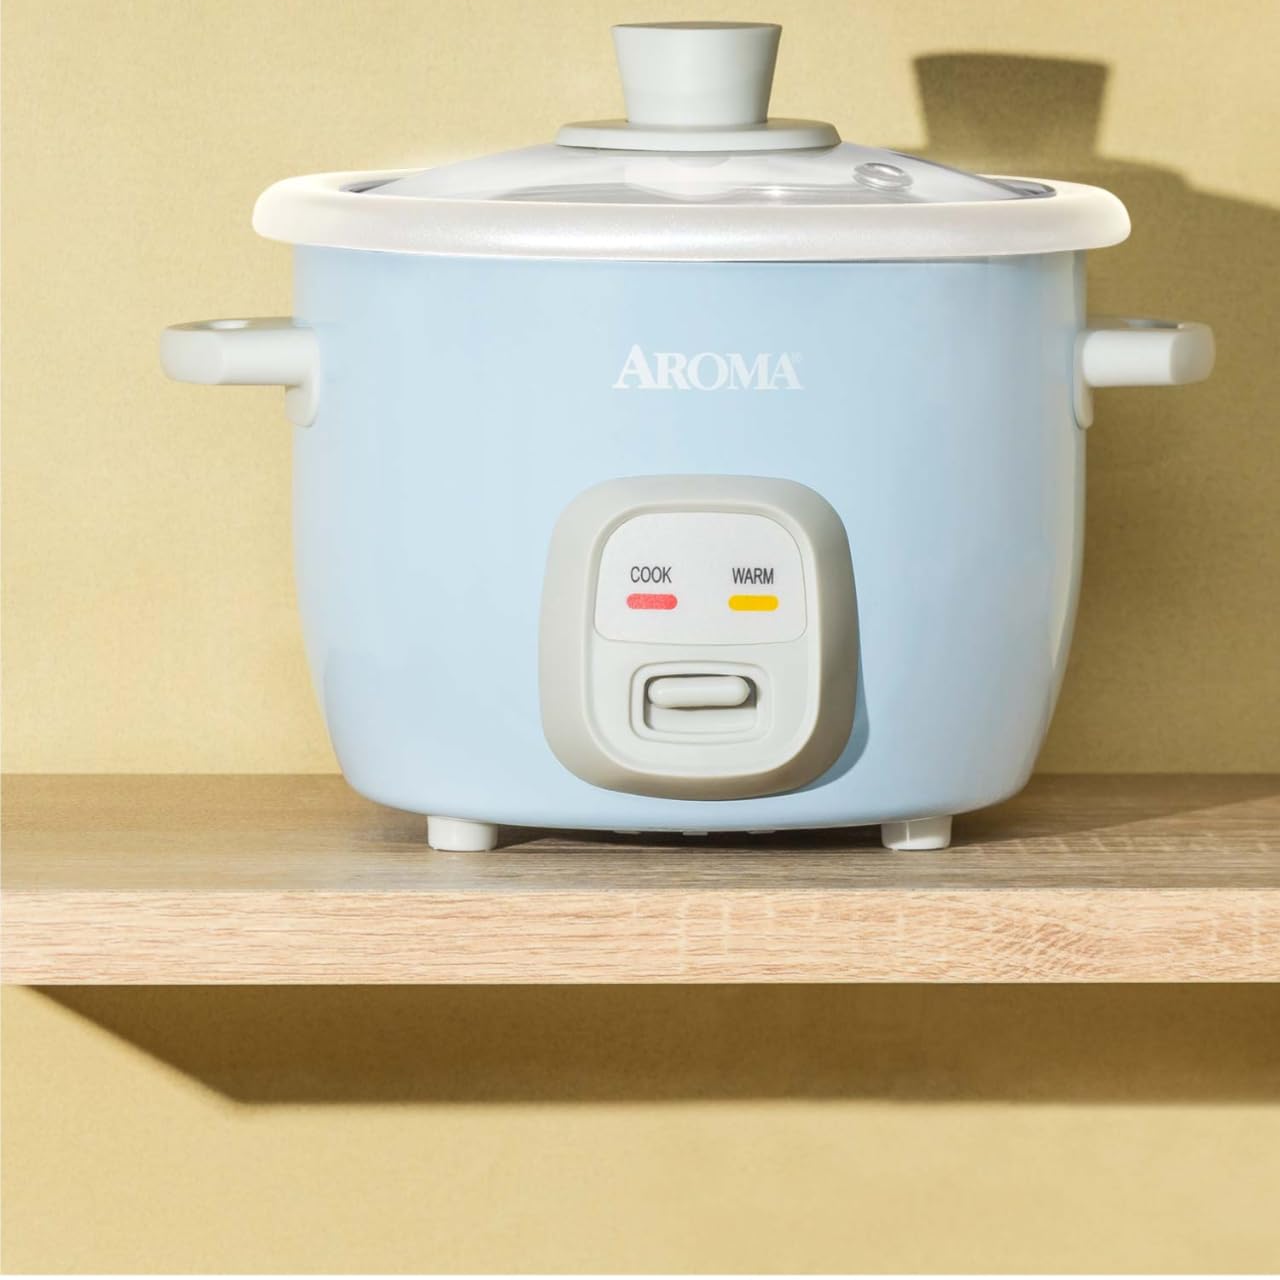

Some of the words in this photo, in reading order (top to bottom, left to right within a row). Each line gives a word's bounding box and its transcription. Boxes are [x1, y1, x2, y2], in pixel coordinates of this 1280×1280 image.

[611, 343, 805, 391] AROMA
[630, 565, 672, 584] COOK
[731, 567, 774, 585] WARM
